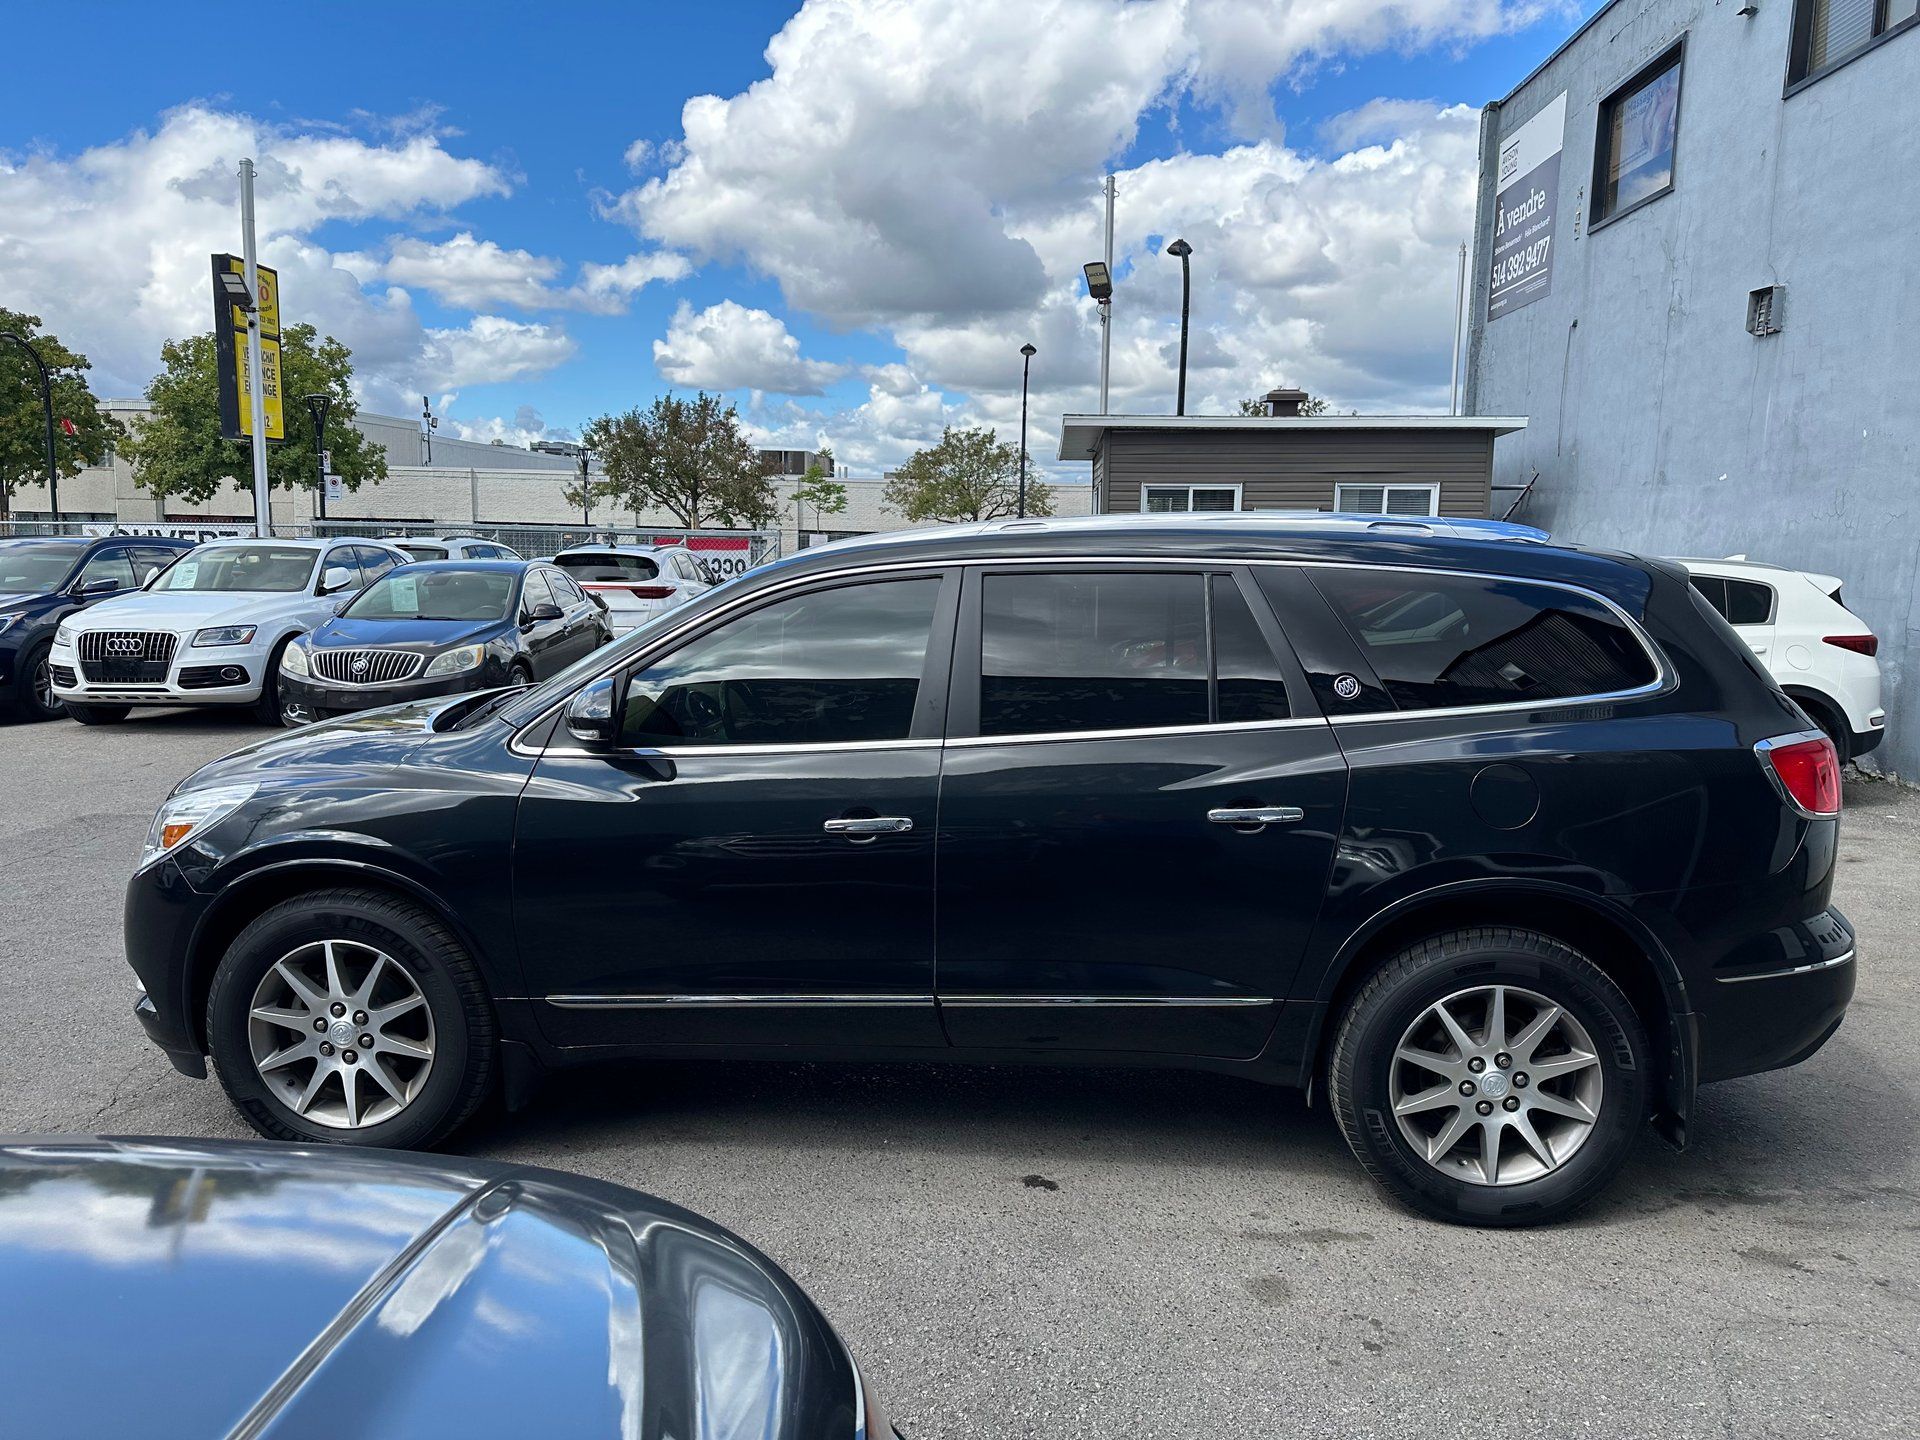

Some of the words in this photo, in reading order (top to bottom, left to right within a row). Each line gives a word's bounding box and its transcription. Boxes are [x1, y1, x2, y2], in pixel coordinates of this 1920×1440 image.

[1496, 201, 1505, 237] À
[1506, 188, 1546, 229] vendre
[1492, 260, 1506, 289] 514
[1507, 250, 1525, 281] 392
[1525, 235, 1551, 272] 9477
